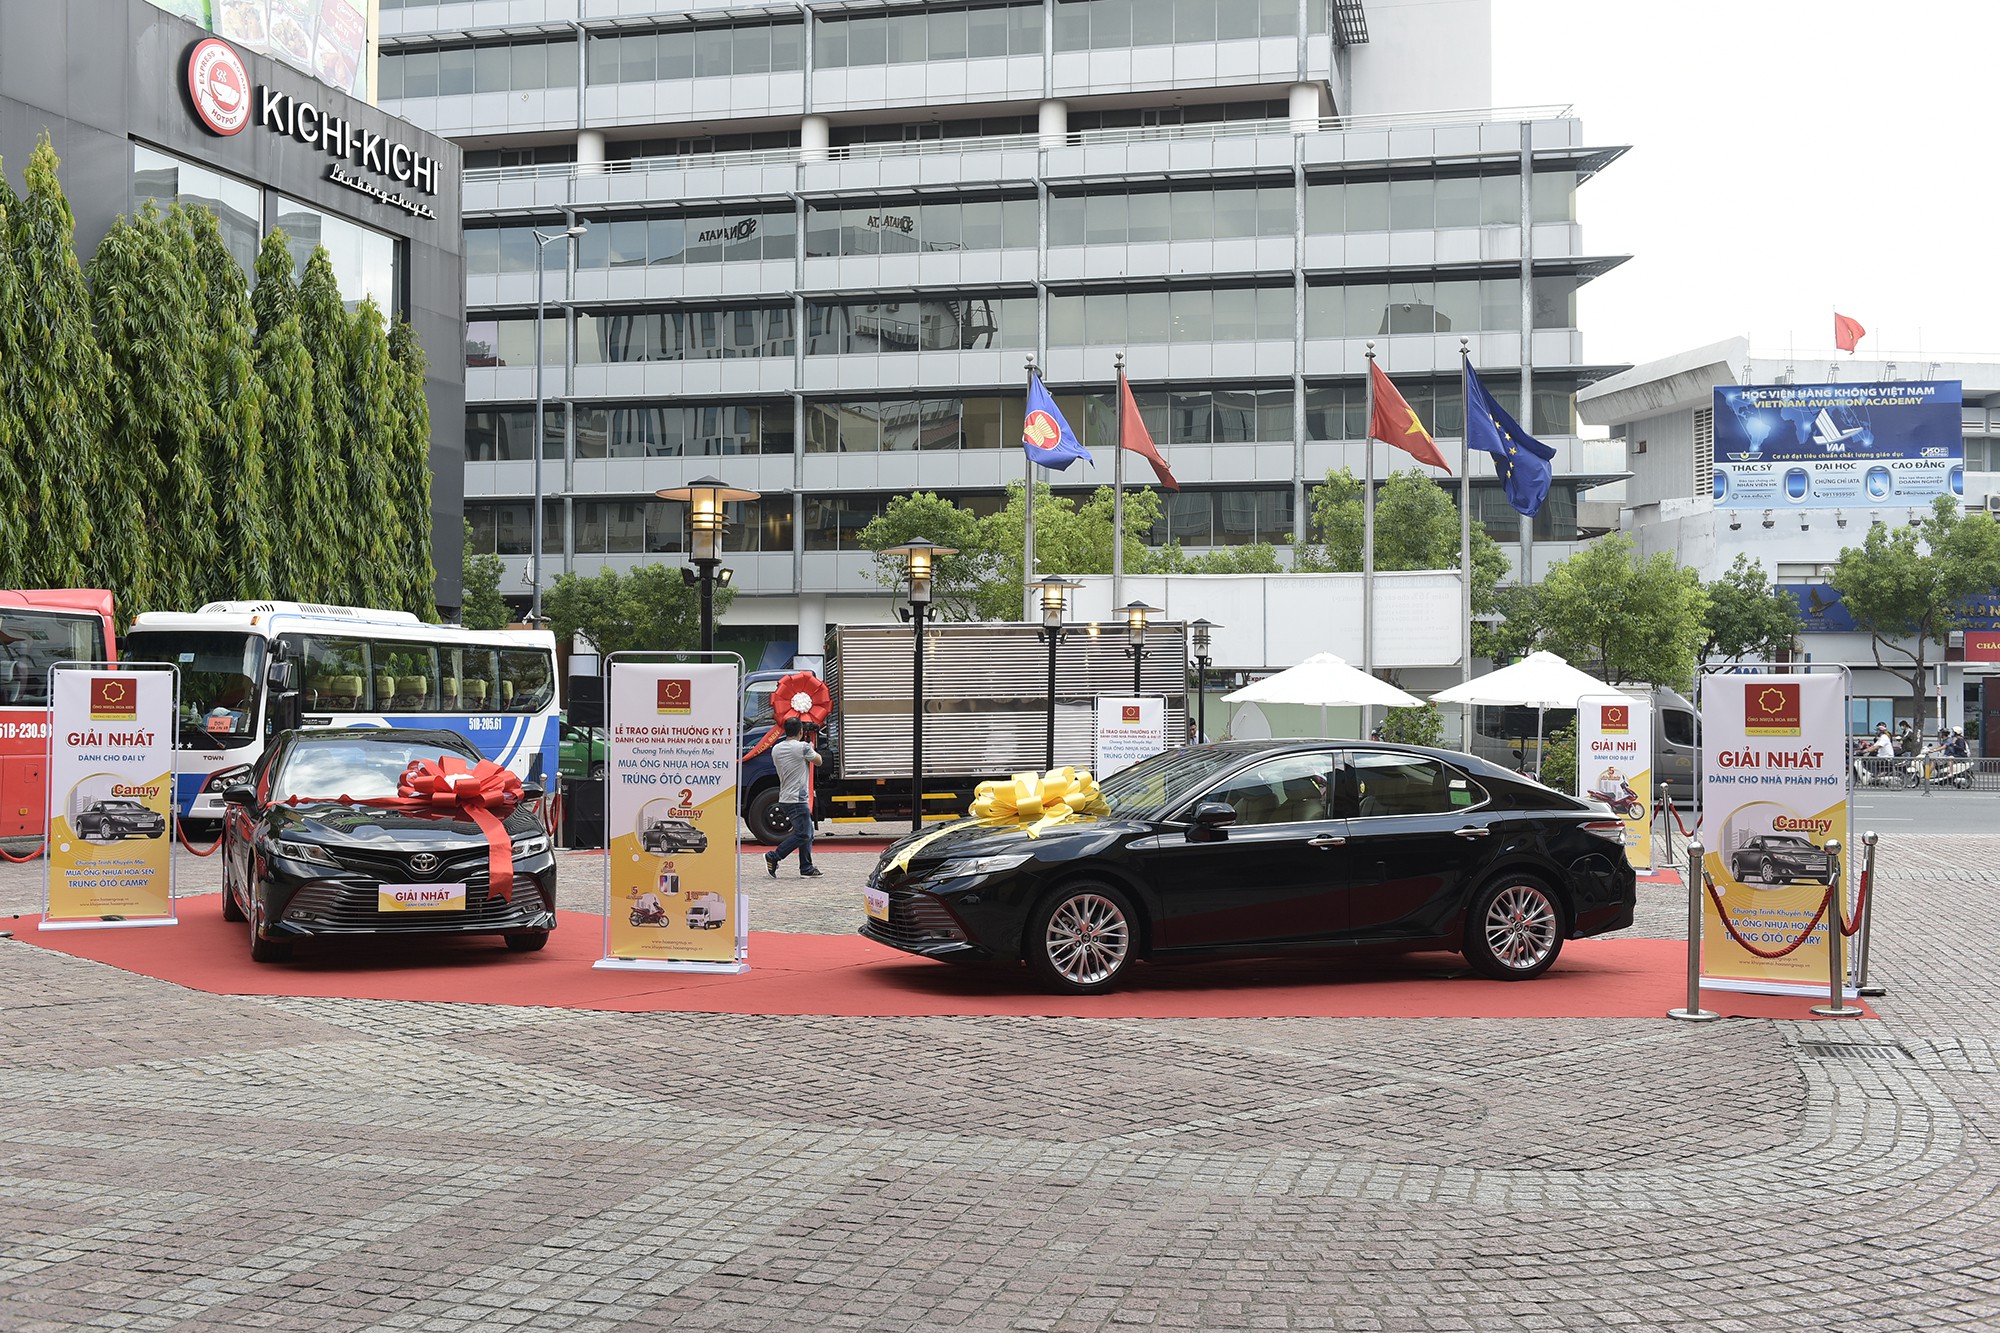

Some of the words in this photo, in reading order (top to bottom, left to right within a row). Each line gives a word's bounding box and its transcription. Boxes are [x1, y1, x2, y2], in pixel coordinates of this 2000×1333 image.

[199, 51, 215, 84] EXPRESS
[211, 108, 237, 124] HOTPOT
[262, 85, 438, 195] KICHI-KICHI
[1742, 390, 1767, 401] HỌC
[1769, 388, 1795, 400] VIỆN
[1799, 387, 1832, 398] HÀNG
[1834, 386, 1878, 397] KHÔNG
[1879, 386, 1906, 398] VIỆT
[1907, 387, 1935, 396] NAM
[1753, 399, 1807, 409] VIETNAM
[1808, 398, 1863, 408] AVIATION
[1865, 397, 1923, 406] ACADEMY
[1826, 443, 1846, 452] VAA
[1732, 464, 1758, 473] THẠC
[1815, 463, 1833, 471] ĐẠI
[1835, 462, 1857, 471] HỌC
[1914, 459, 1945, 469] ĐẲNG
[469, 717, 502, 730] 51B-205.61
[615, 723, 624, 735] LỄ
[626, 727, 648, 735] TRAO
[651, 725, 669, 735] GIẢI
[672, 725, 709, 735] THƯỞNG
[727, 727, 731, 735] 1
[66, 728, 102, 747] GIẢI
[107, 727, 155, 747] NHẤT
[687, 736, 704, 744] PHỐI
[712, 738, 724, 746] ĐẠI
[1591, 738, 1613, 751] GIẢI
[1617, 739, 1637, 751] NHÌ
[632, 747, 657, 756] Chương
[1717, 746, 1760, 769] GIẢI
[1766, 745, 1824, 769] NHẤT
[122, 755, 136, 763] ĐẠI
[618, 760, 637, 768] MUA
[640, 758, 661, 768] ỐNG
[663, 760, 688, 769] NHỰA
[691, 761, 710, 769] HOA
[712, 761, 729, 769] SEN
[1608, 766, 1615, 775] 5
[622, 772, 656, 784] TRÚNG
[660, 772, 682, 784] ÔTÔ
[685, 775, 721, 785] CAMRY
[1709, 774, 1735, 784] DÀNH
[1738, 775, 1758, 784] CHO
[1761, 774, 1782, 784] NHÀ
[1784, 775, 1811, 785] PHÂN
[1814, 773, 1838, 785] PHỐI
[112, 784, 160, 798] Camry
[679, 788, 693, 807] 2
[668, 807, 703, 819] Camry
[1773, 815, 1833, 833] Camry
[663, 861, 674, 869] 20
[84, 867, 100, 876] ỐNG
[68, 878, 97, 888] TRÚNG
[120, 879, 148, 887] CAMRY
[395, 889, 417, 901] GIẢI
[421, 887, 450, 901] NHẤT
[631, 886, 638, 895] 5
[1732, 907, 1757, 916] Chương
[1742, 918, 1762, 928] ỐNG
[1764, 921, 1788, 929] NHỰA
[1791, 922, 1809, 930] HOA
[1761, 932, 1783, 943] ÔTÔ
[1786, 934, 1821, 944] CARY
